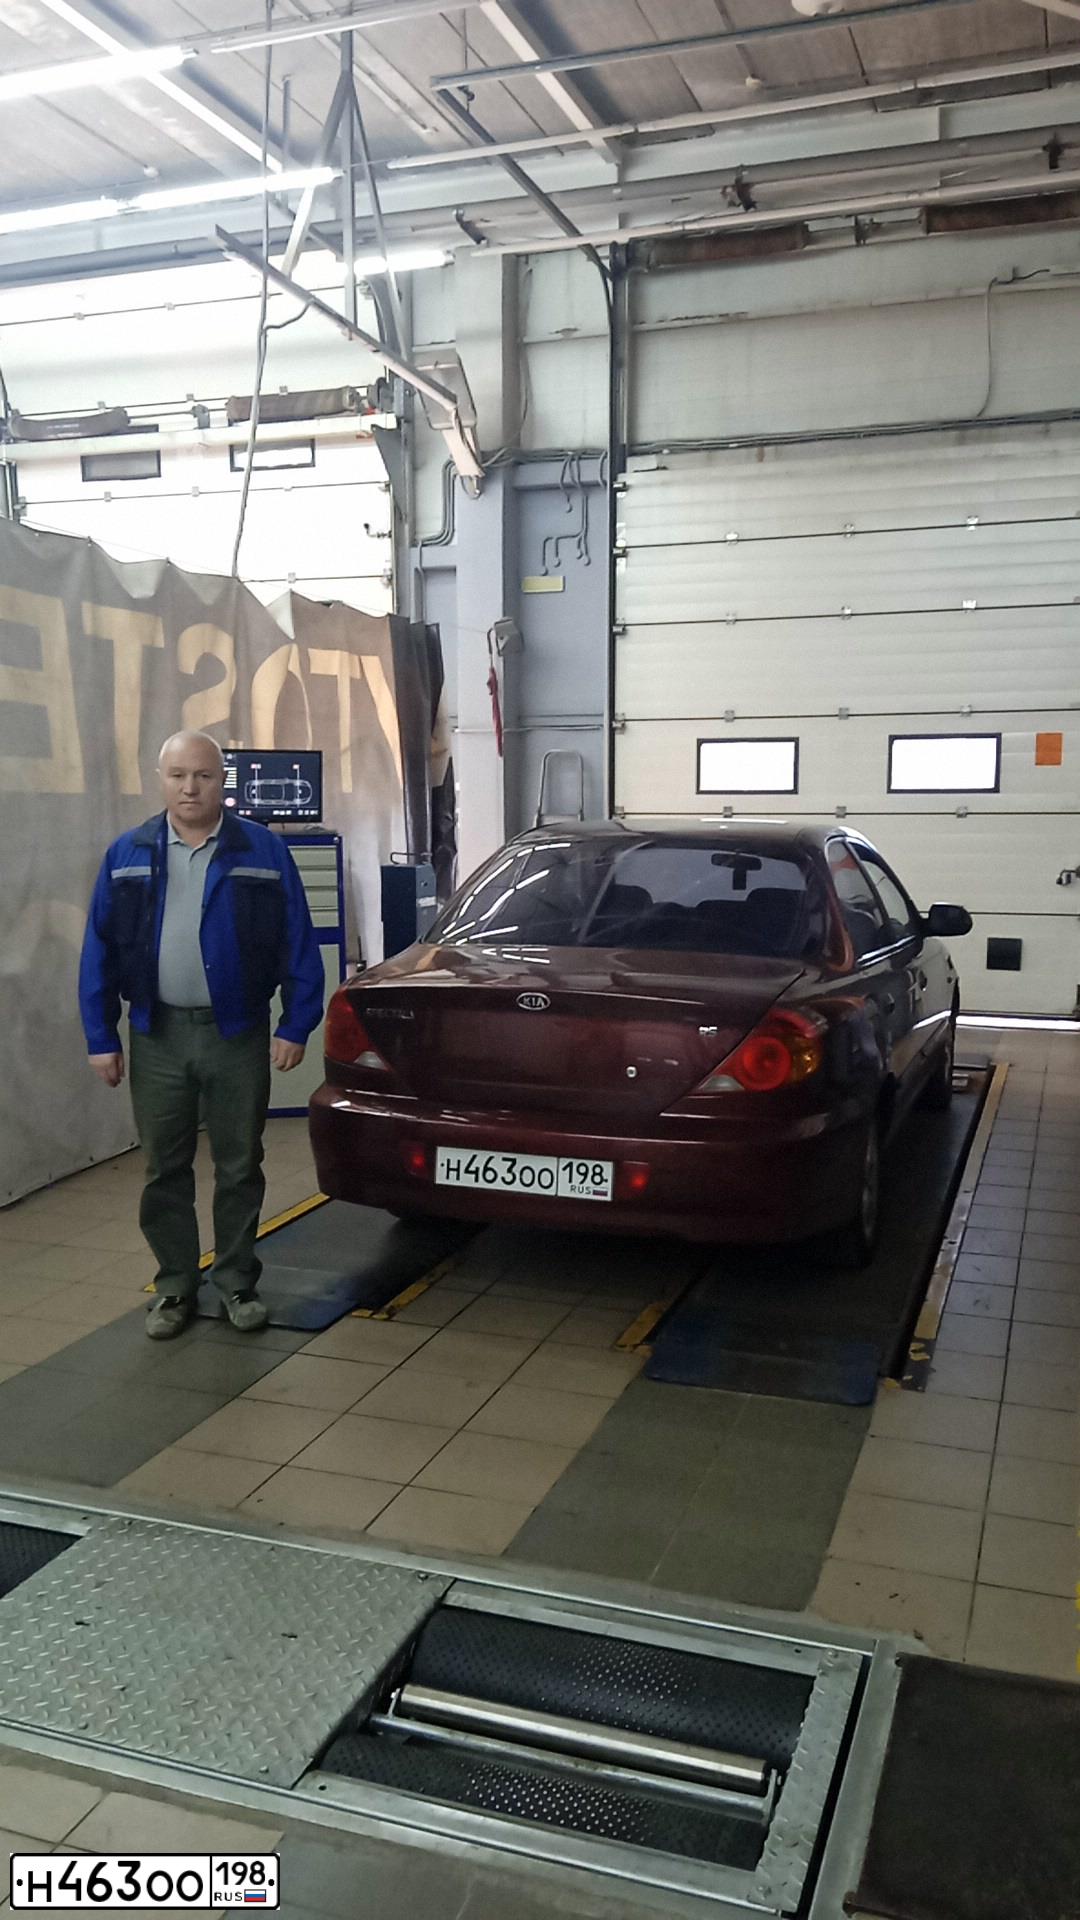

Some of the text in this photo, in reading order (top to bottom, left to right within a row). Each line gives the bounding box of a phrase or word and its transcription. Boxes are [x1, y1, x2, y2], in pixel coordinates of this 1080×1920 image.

[522, 996, 546, 1009] KIA
[561, 1161, 605, 1186] 198
[569, 1184, 592, 1195] RUS
